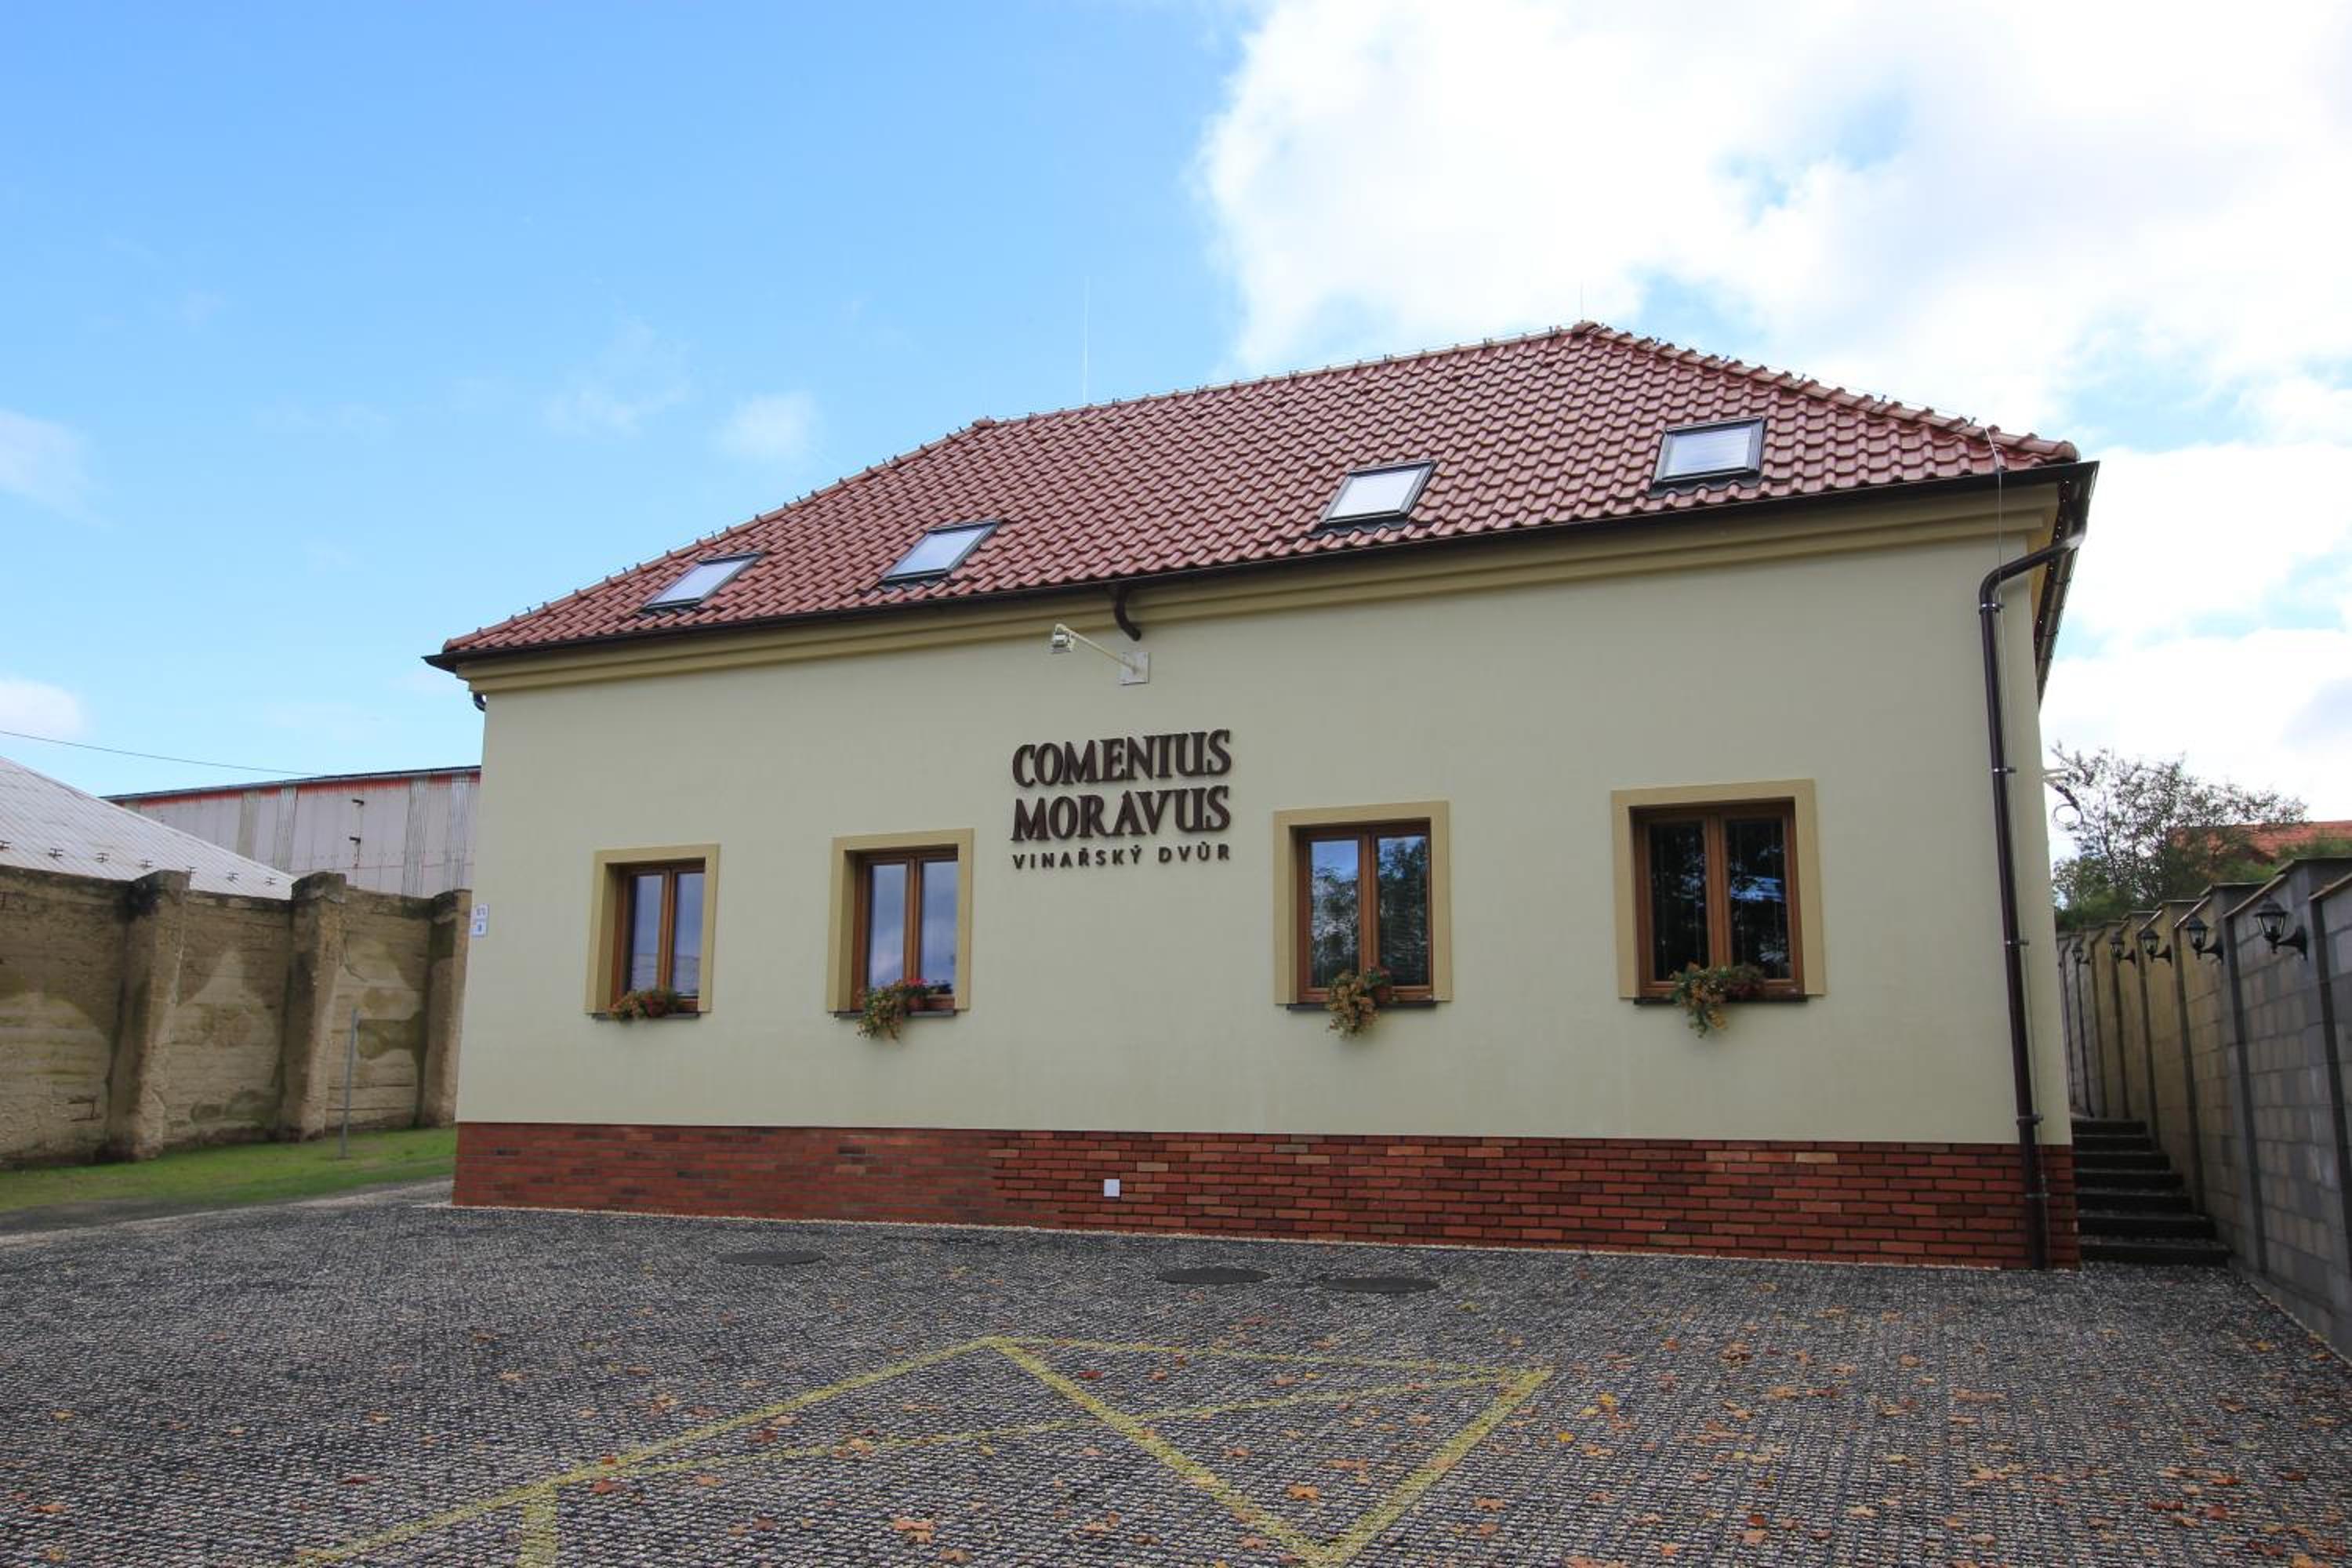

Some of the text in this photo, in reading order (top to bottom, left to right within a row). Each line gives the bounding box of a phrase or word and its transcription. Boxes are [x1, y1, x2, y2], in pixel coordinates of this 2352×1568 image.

[1012, 729, 1232, 788] COMENIUS
[1011, 786, 1231, 841] MORAVUS
[1012, 841, 1230, 869] VINAŘSKÝ DVŮR
